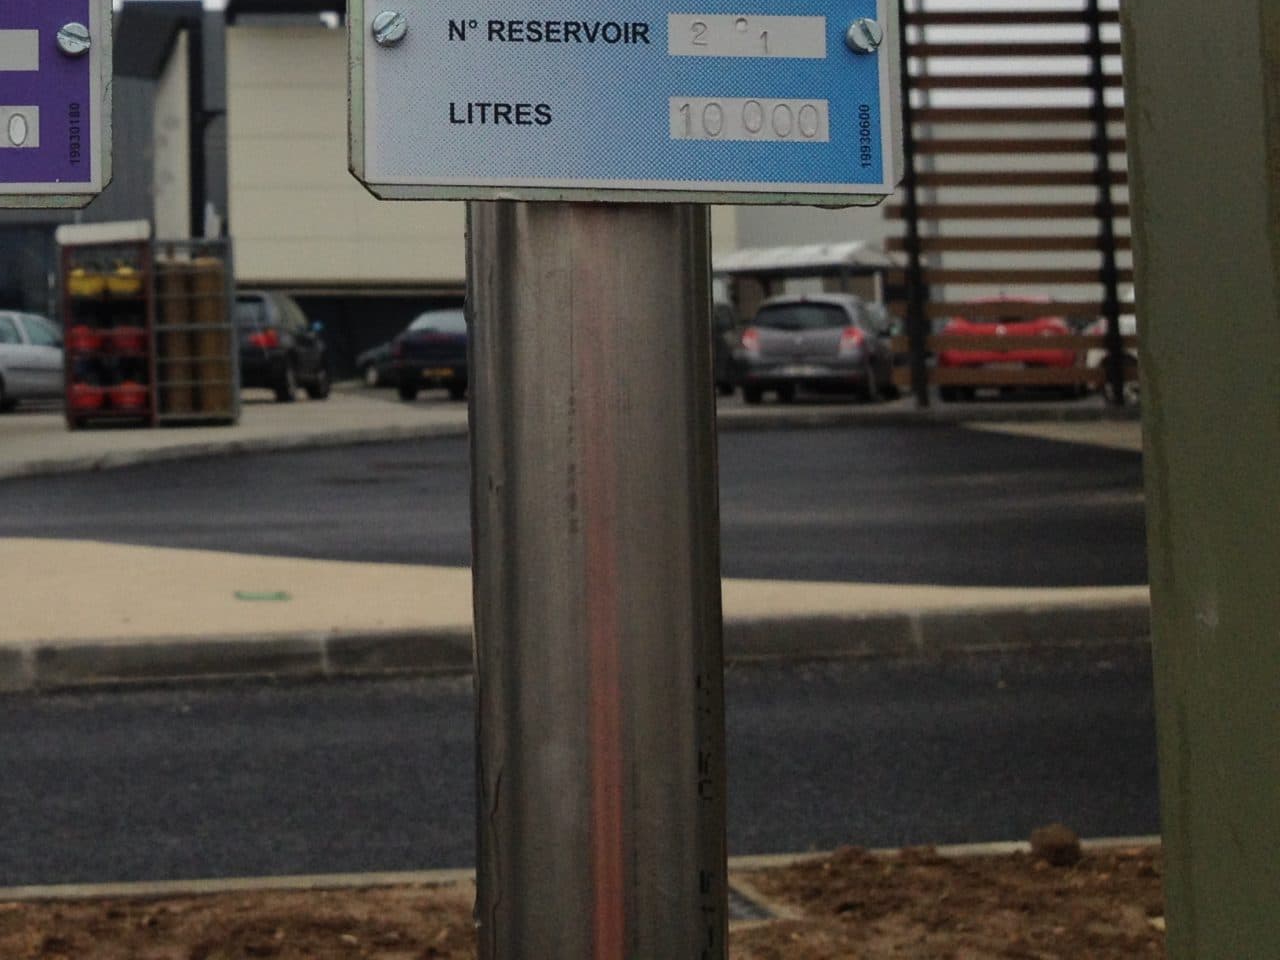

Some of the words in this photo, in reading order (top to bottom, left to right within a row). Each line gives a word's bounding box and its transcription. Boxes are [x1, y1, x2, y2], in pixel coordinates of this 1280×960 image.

[448, 19, 479, 42] N°
[487, 20, 651, 45] RESERVOIR
[448, 101, 553, 126] LITRES
